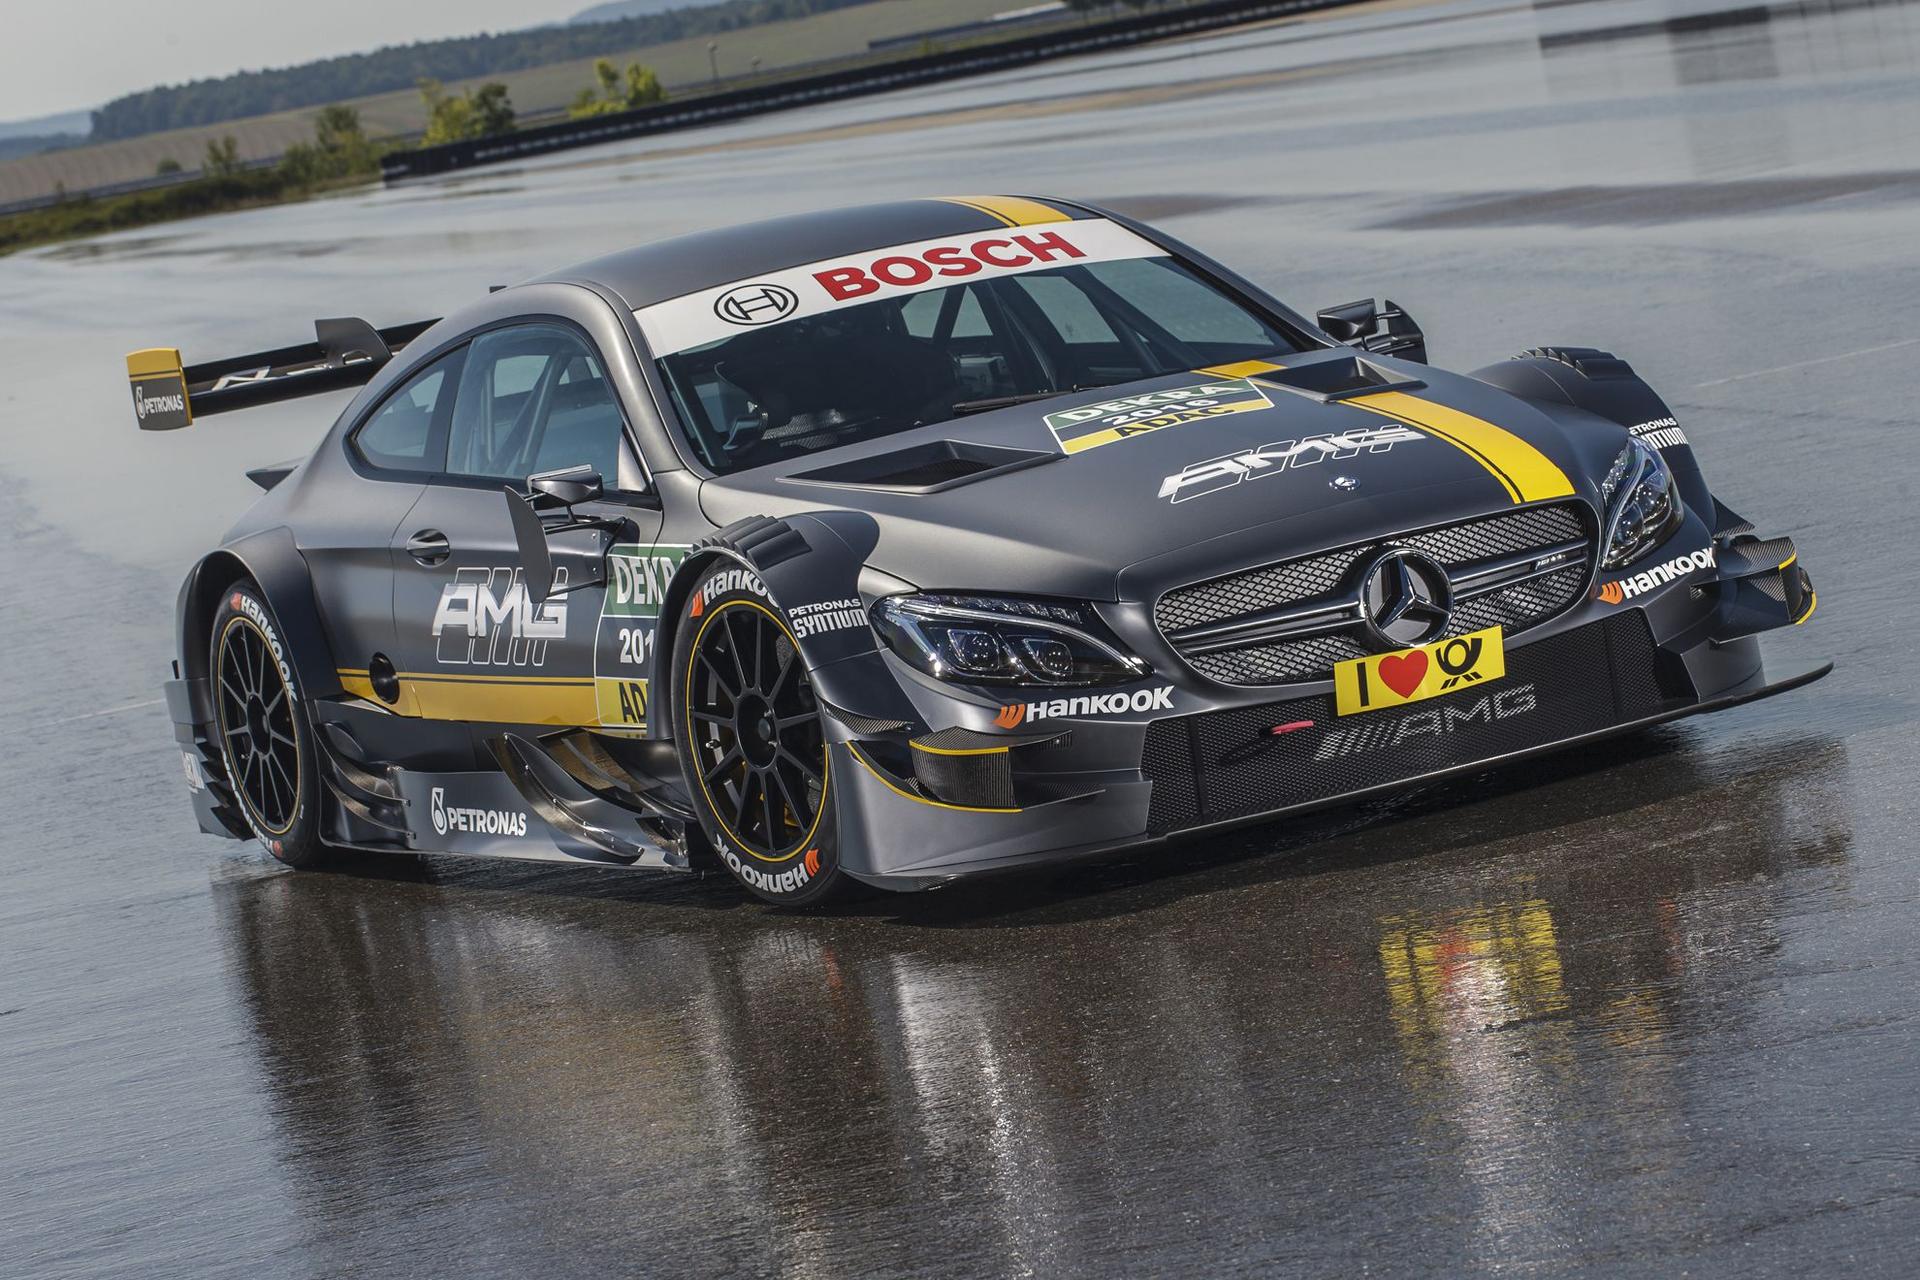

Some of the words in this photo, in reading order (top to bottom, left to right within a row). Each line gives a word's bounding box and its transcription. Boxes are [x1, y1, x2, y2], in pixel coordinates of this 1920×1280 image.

[811, 231, 1087, 302] BOSCH
[144, 394, 184, 414] PETRONAS
[1058, 385, 1243, 421] DEKRA
[1102, 399, 1219, 425] 2016
[1113, 406, 1234, 438] ADAC
[1628, 417, 1677, 435] ETRONAS
[1640, 427, 1689, 449] NTIUM
[1158, 428, 1427, 498] AMG
[703, 569, 781, 608] Hanko
[432, 583, 568, 638] AMG
[788, 598, 862, 618] PETRONAS
[792, 609, 868, 639] SYNTIUM
[619, 628, 655, 664] 201
[1356, 661, 1370, 707] I
[619, 682, 648, 724] AD
[446, 807, 527, 836] PETRONAS
